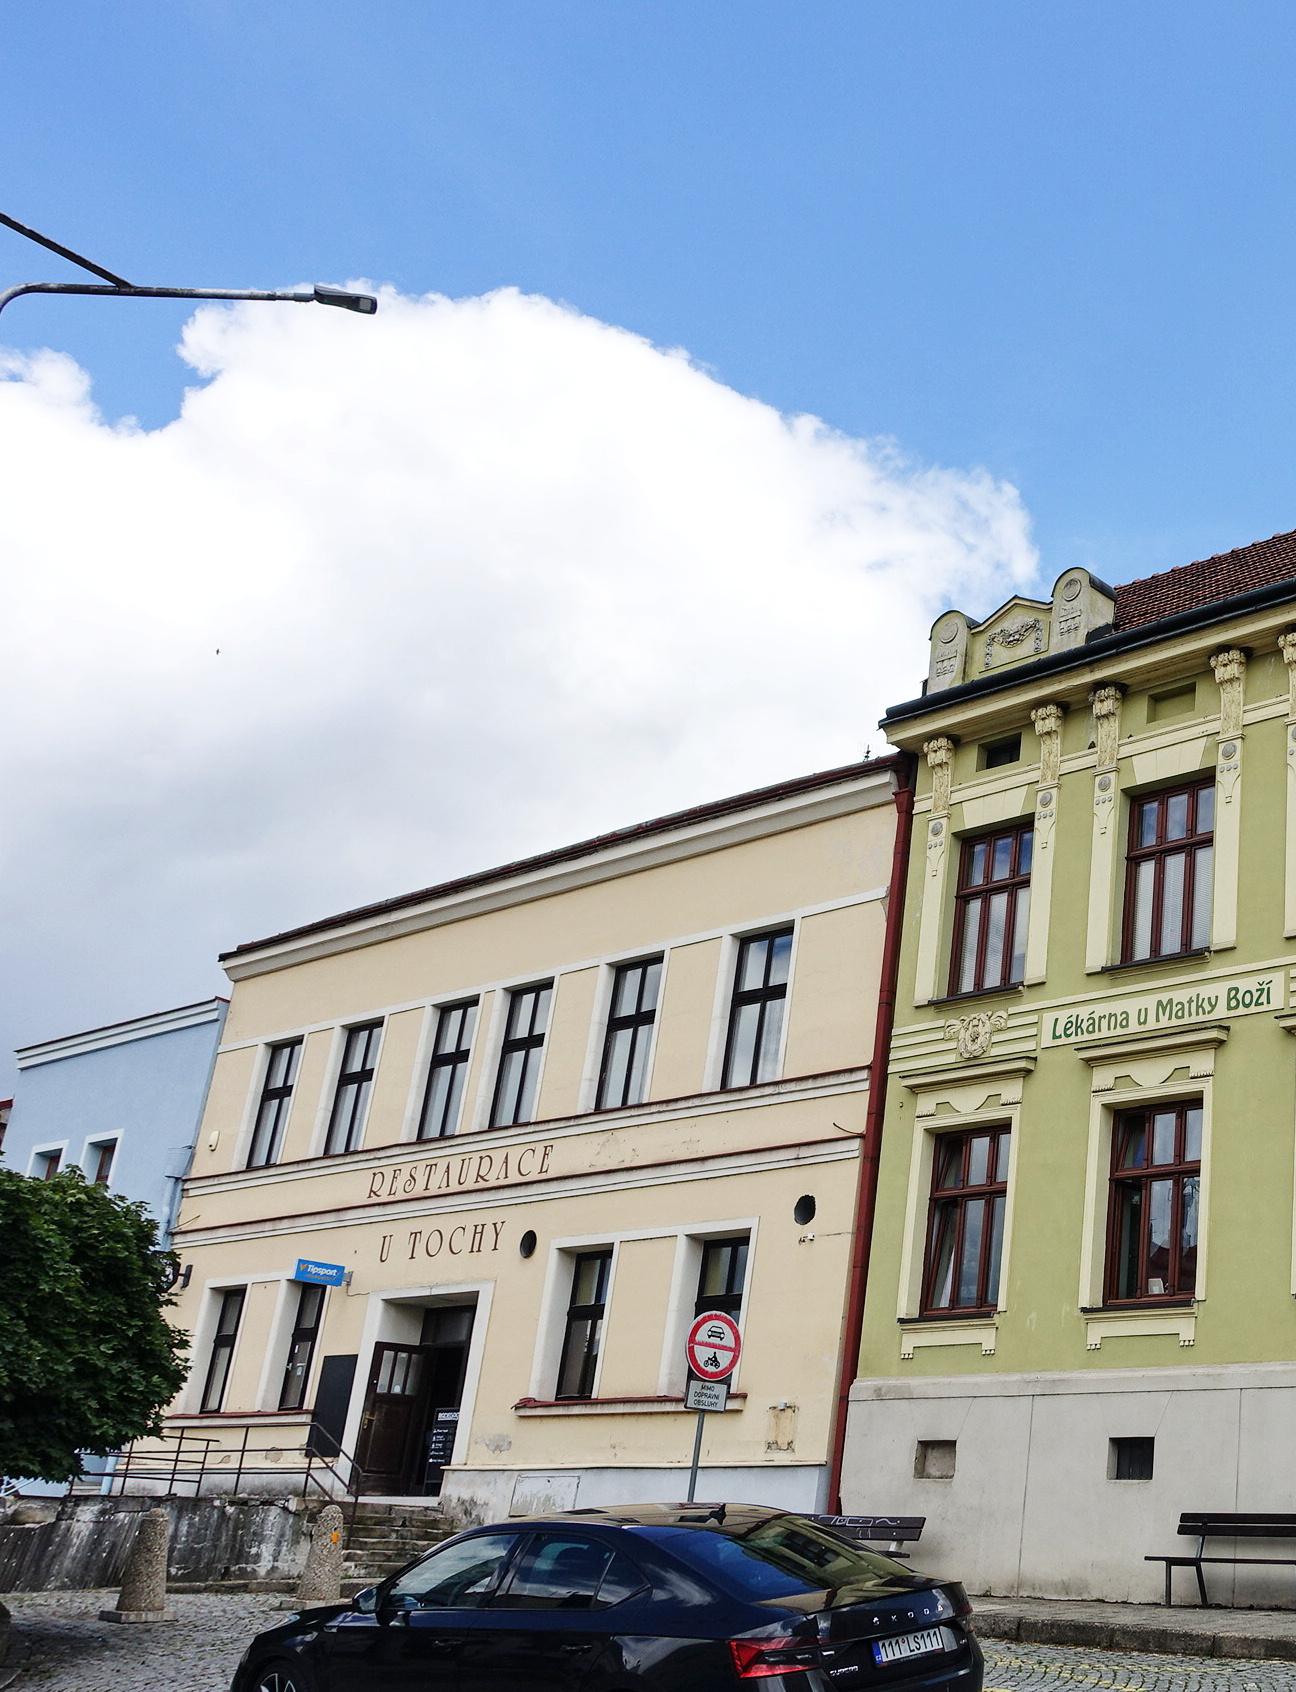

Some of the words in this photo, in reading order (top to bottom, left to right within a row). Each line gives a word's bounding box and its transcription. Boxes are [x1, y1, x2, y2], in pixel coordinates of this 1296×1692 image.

[1051, 1009, 1130, 1040] Lékárna
[1137, 1007, 1148, 1025] u
[1155, 993, 1219, 1023] Matky
[1226, 980, 1273, 1011] Boží
[367, 1145, 554, 1199] RESTAURACE
[379, 1234, 394, 1263] U
[407, 1221, 506, 1260] TOCHY
[307, 1264, 338, 1276] Tipsport
[701, 1384, 715, 1392] MIMO
[693, 1399, 719, 1407] OBSLUHY
